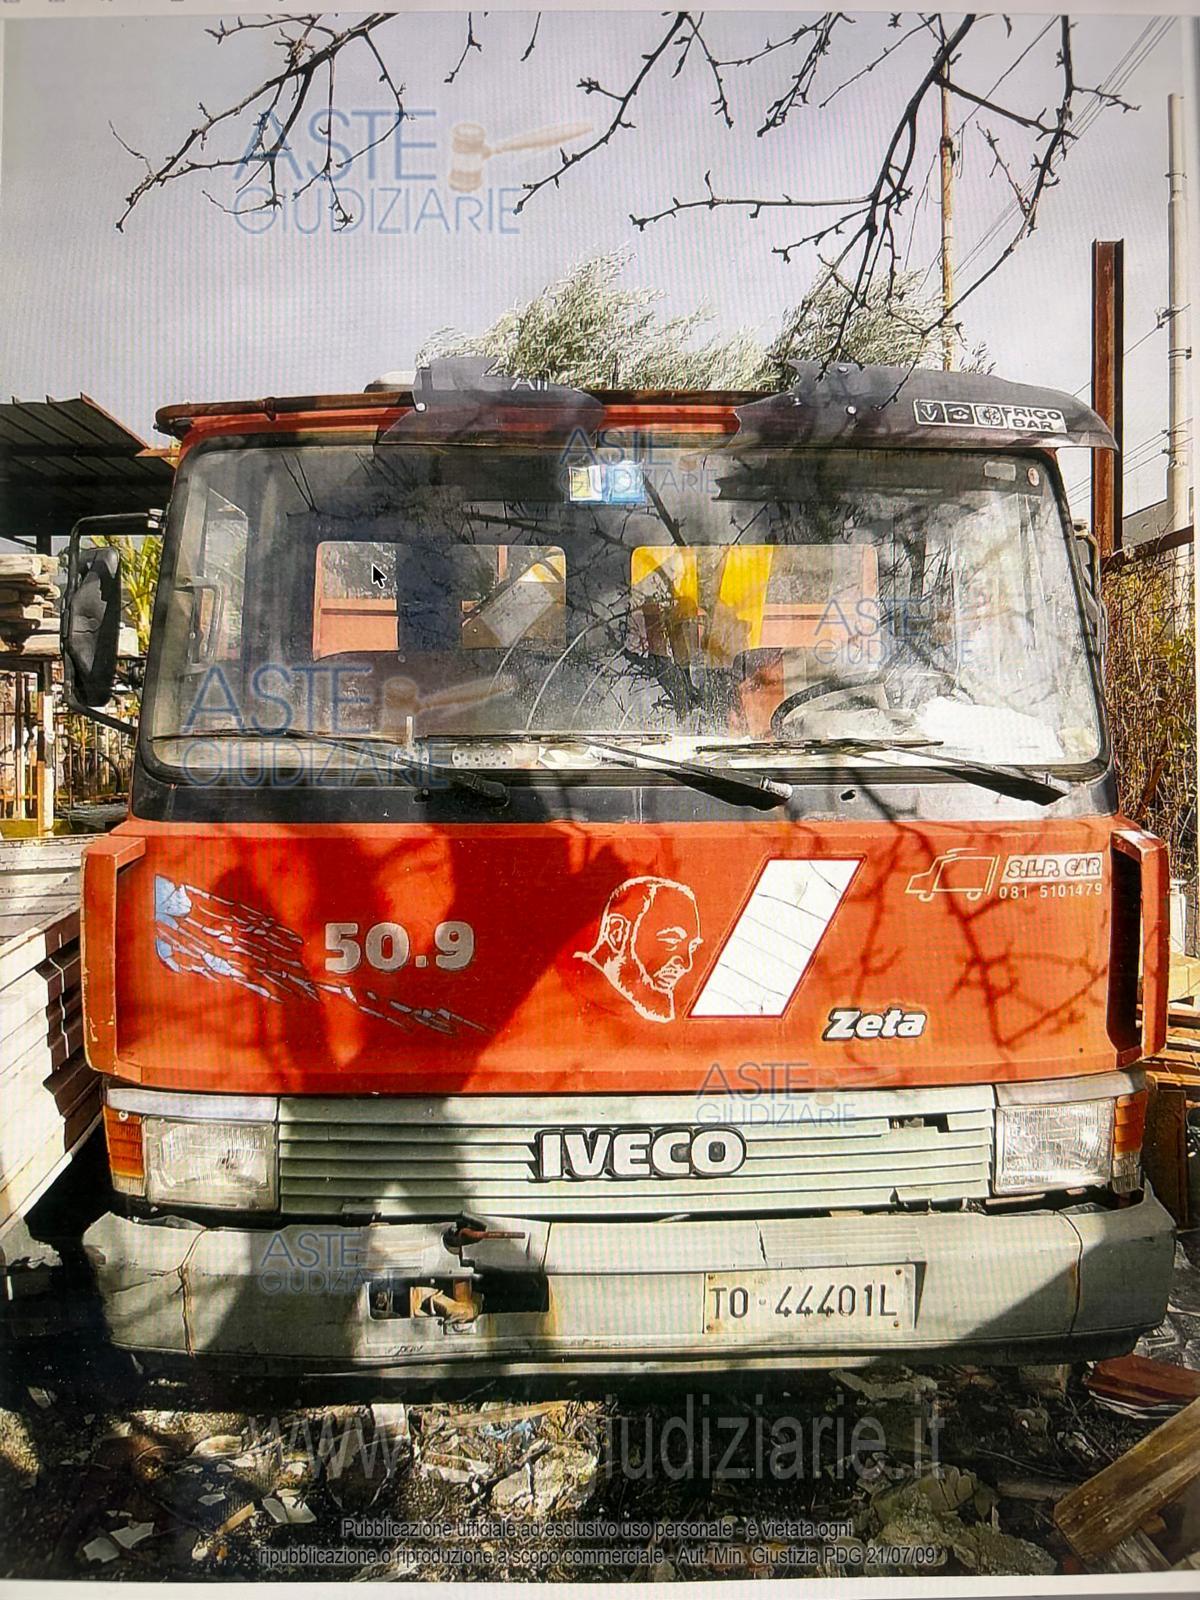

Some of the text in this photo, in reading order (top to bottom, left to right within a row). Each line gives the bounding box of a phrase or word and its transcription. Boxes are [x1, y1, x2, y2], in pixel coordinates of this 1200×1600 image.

[1002, 406, 1061, 421] FRIGO
[1013, 419, 1054, 431] BAR
[1006, 858, 1101, 878] S.L.P. CAR
[999, 883, 1103, 900] 081 5101479
[324, 921, 475, 974] 50.9
[822, 1007, 927, 1041] Zeta
[534, 1127, 746, 1180] IVECO
[709, 1284, 898, 1319] TO 44401L
